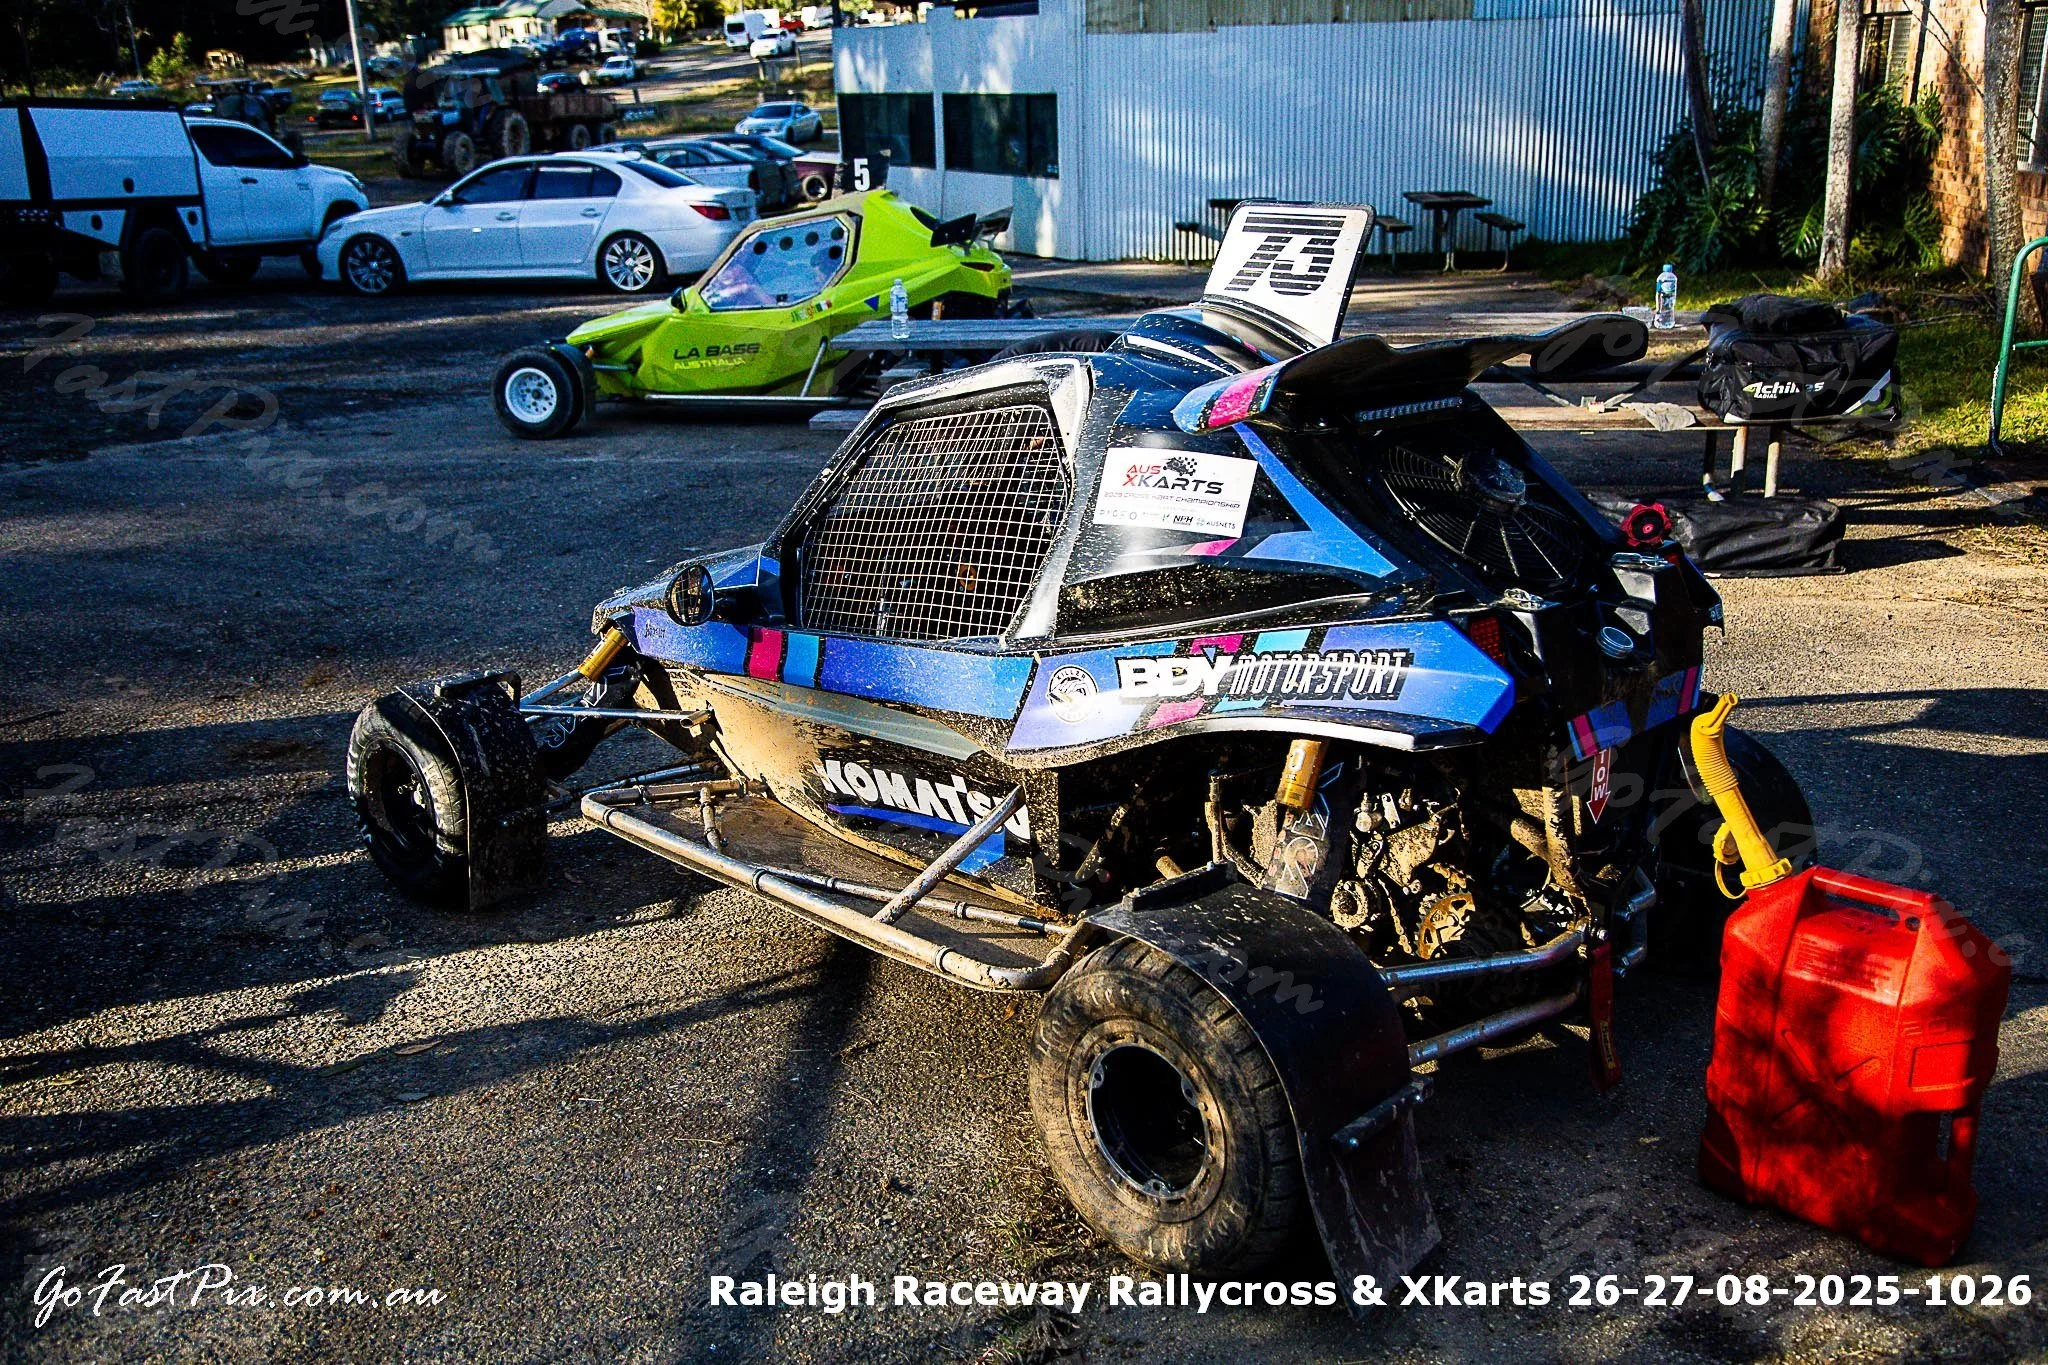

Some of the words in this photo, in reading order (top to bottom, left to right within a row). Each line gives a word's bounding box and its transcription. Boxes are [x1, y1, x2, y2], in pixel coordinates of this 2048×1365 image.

[853, 158, 870, 191] 5
[1224, 211, 1347, 296] 73
[674, 347, 700, 360] LA
[674, 357, 746, 370] AUSTRALIA
[1127, 464, 1162, 475] AUS
[1122, 474, 1224, 495] XKARTS
[1117, 651, 1235, 698] BDY
[1229, 650, 1412, 698] MOTORSPORT
[1594, 751, 1608, 798] TOW
